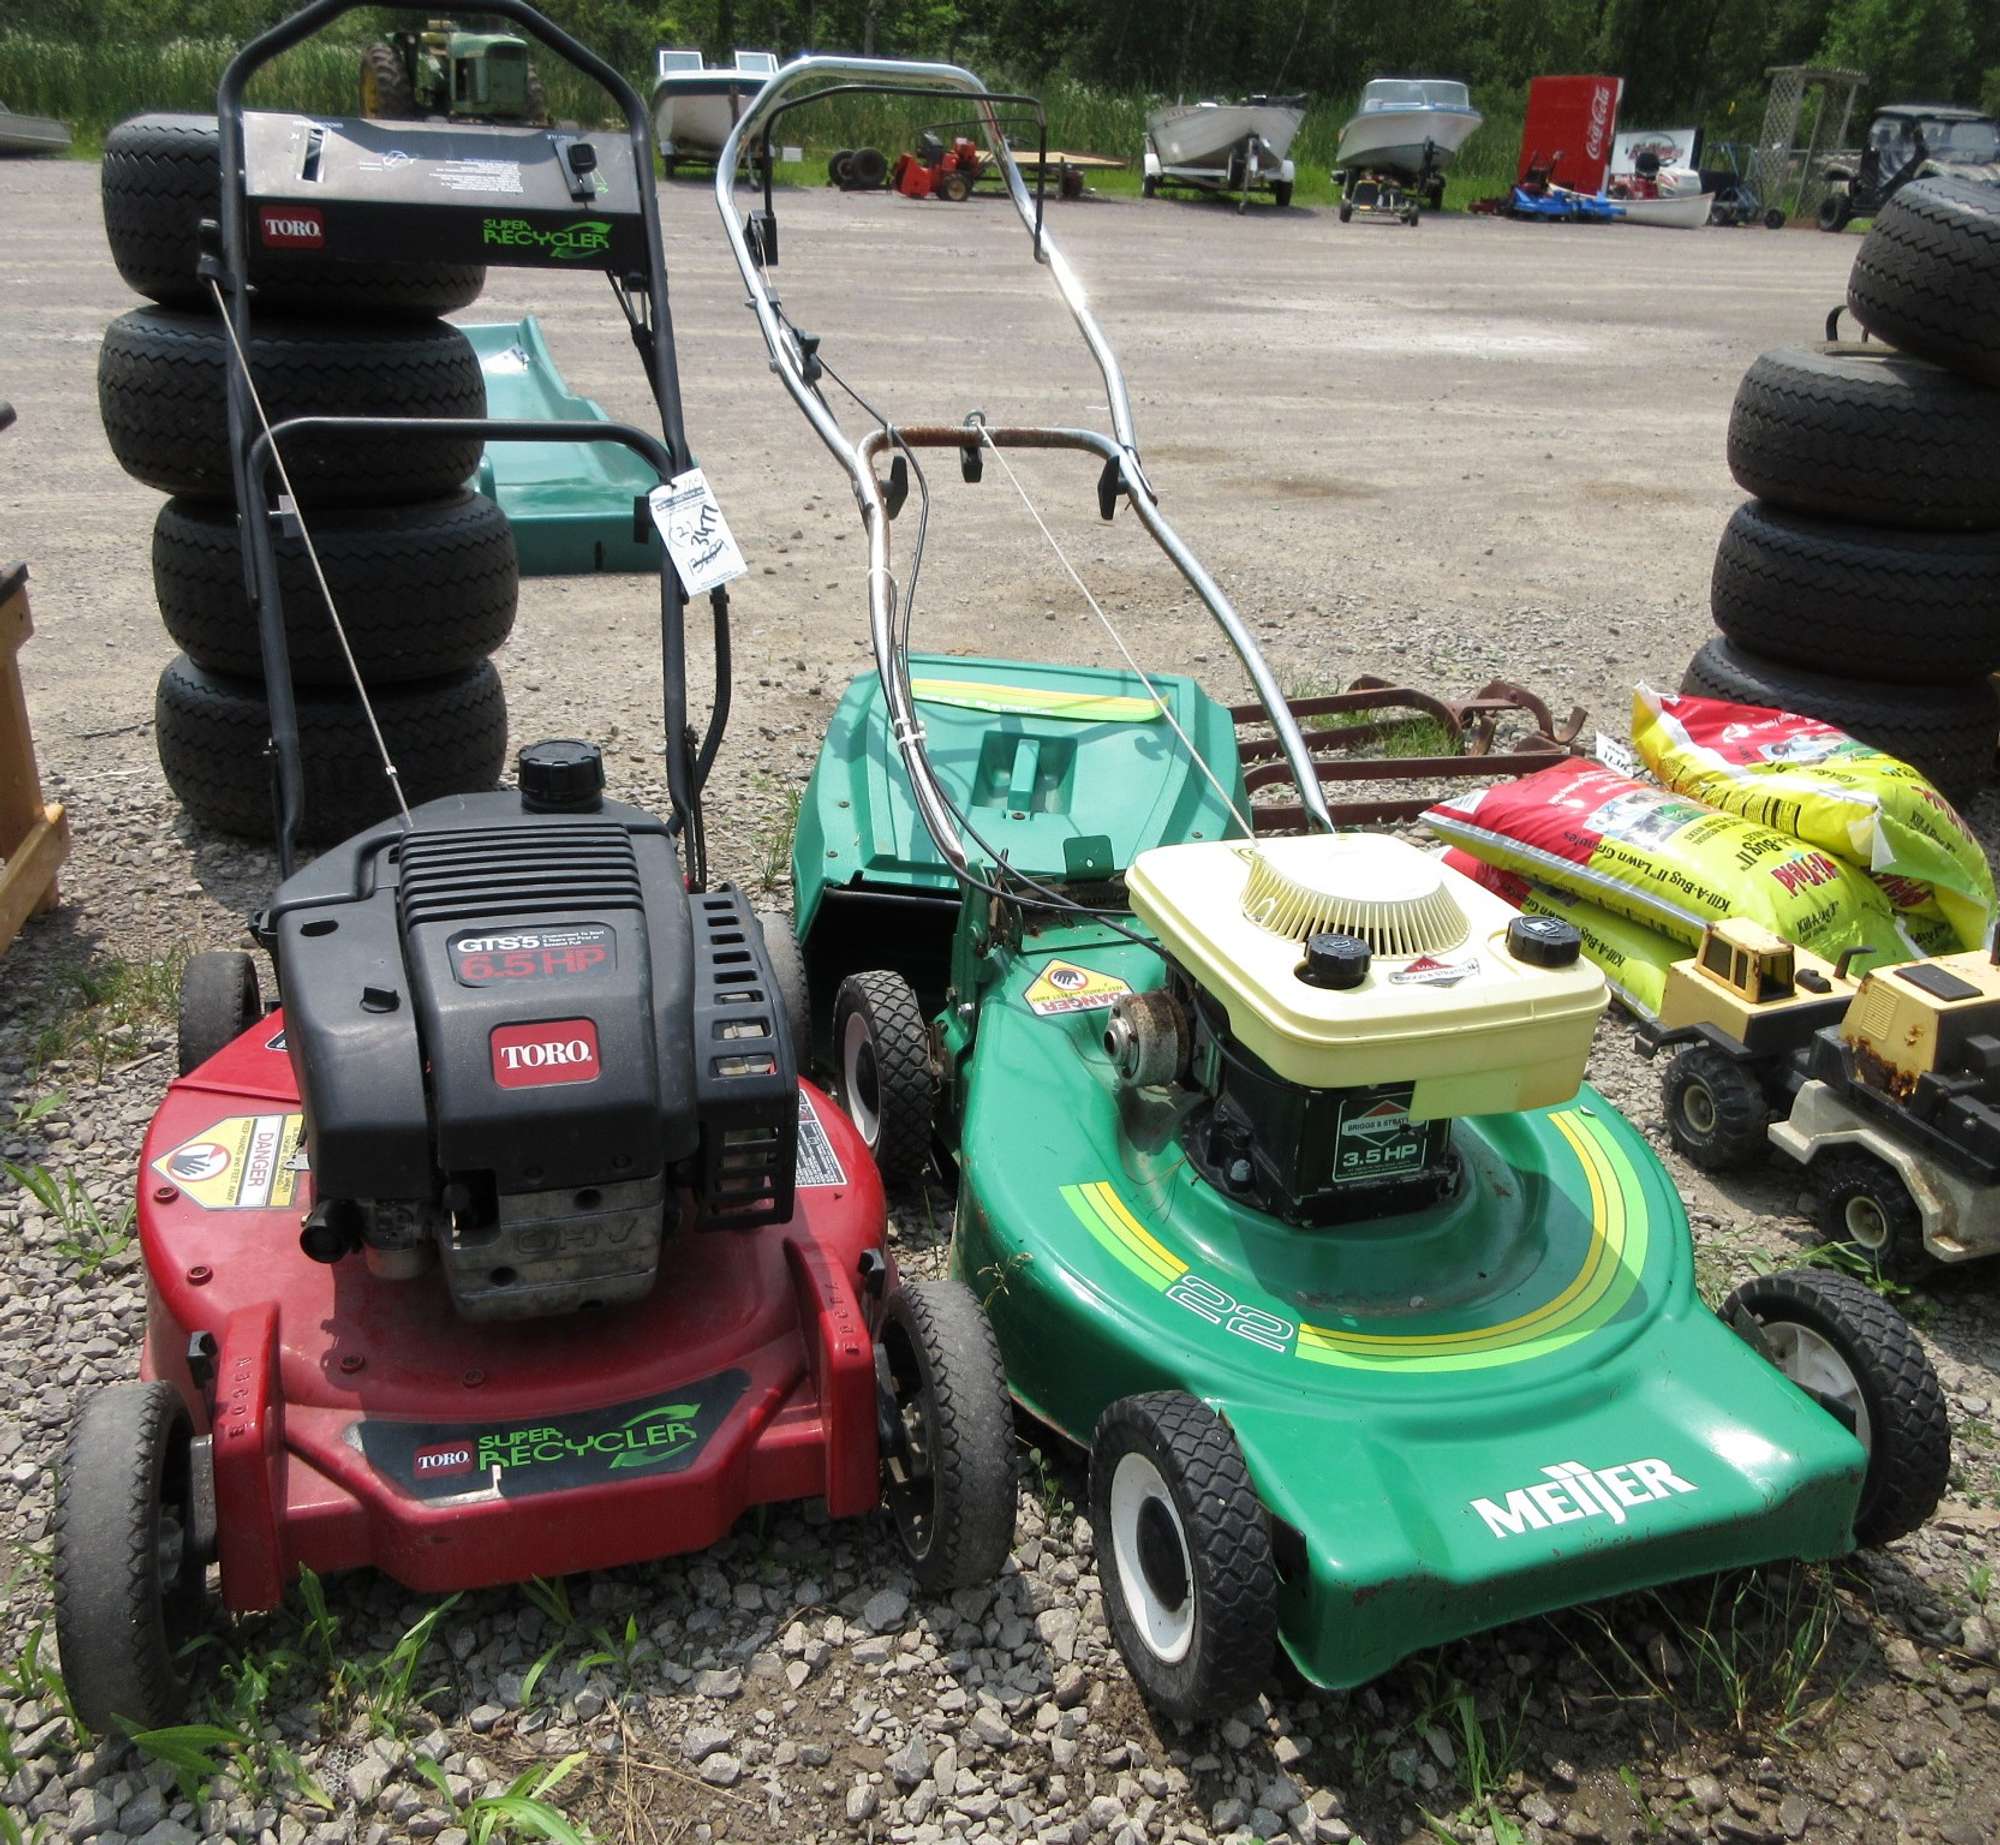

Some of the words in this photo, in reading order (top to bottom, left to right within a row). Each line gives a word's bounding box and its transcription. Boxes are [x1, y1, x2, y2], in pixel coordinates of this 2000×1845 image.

[265, 218, 321, 237] TORO
[483, 219, 531, 231] SUPER
[483, 229, 609, 248] RECYCLER
[1563, 830, 1617, 860] Granules
[1617, 850, 1652, 876] Lawn
[461, 952, 538, 981] 6.5
[543, 946, 608, 976] HP
[1041, 992, 1121, 1012] DANGER
[501, 1040, 592, 1069] TORO
[1348, 1122, 1376, 1132] BRIGGS
[248, 1132, 274, 1187] DANGER
[1342, 1149, 1381, 1167] 3.5
[1384, 1144, 1418, 1161] HP
[1166, 1275, 1294, 1353] 22
[479, 1427, 564, 1448] SUPER
[479, 1422, 698, 1471] RECYCLER
[418, 1450, 470, 1469] TORO
